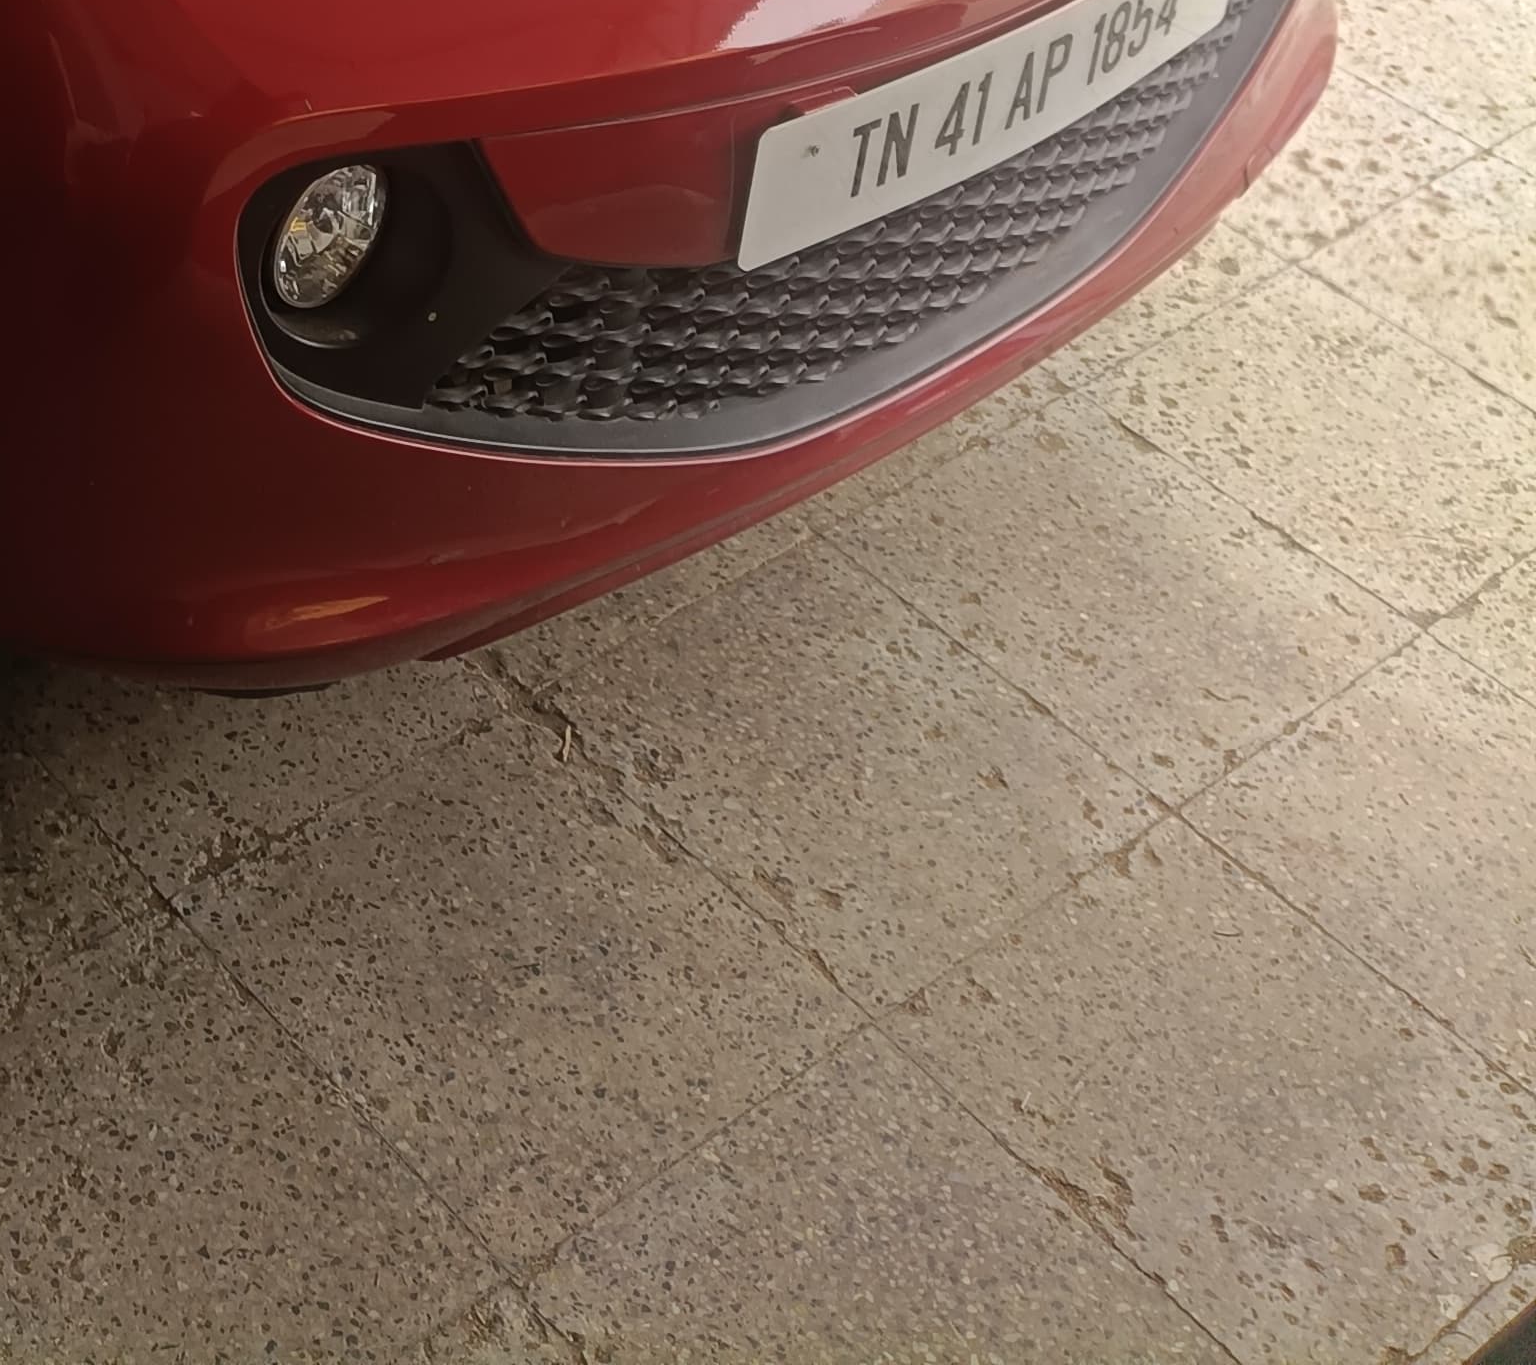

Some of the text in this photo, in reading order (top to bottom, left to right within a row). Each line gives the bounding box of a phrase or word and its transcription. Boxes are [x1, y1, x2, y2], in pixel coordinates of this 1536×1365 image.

[850, 103, 920, 199] TN
[933, 71, 994, 157] 41
[1003, 32, 1073, 131] AP
